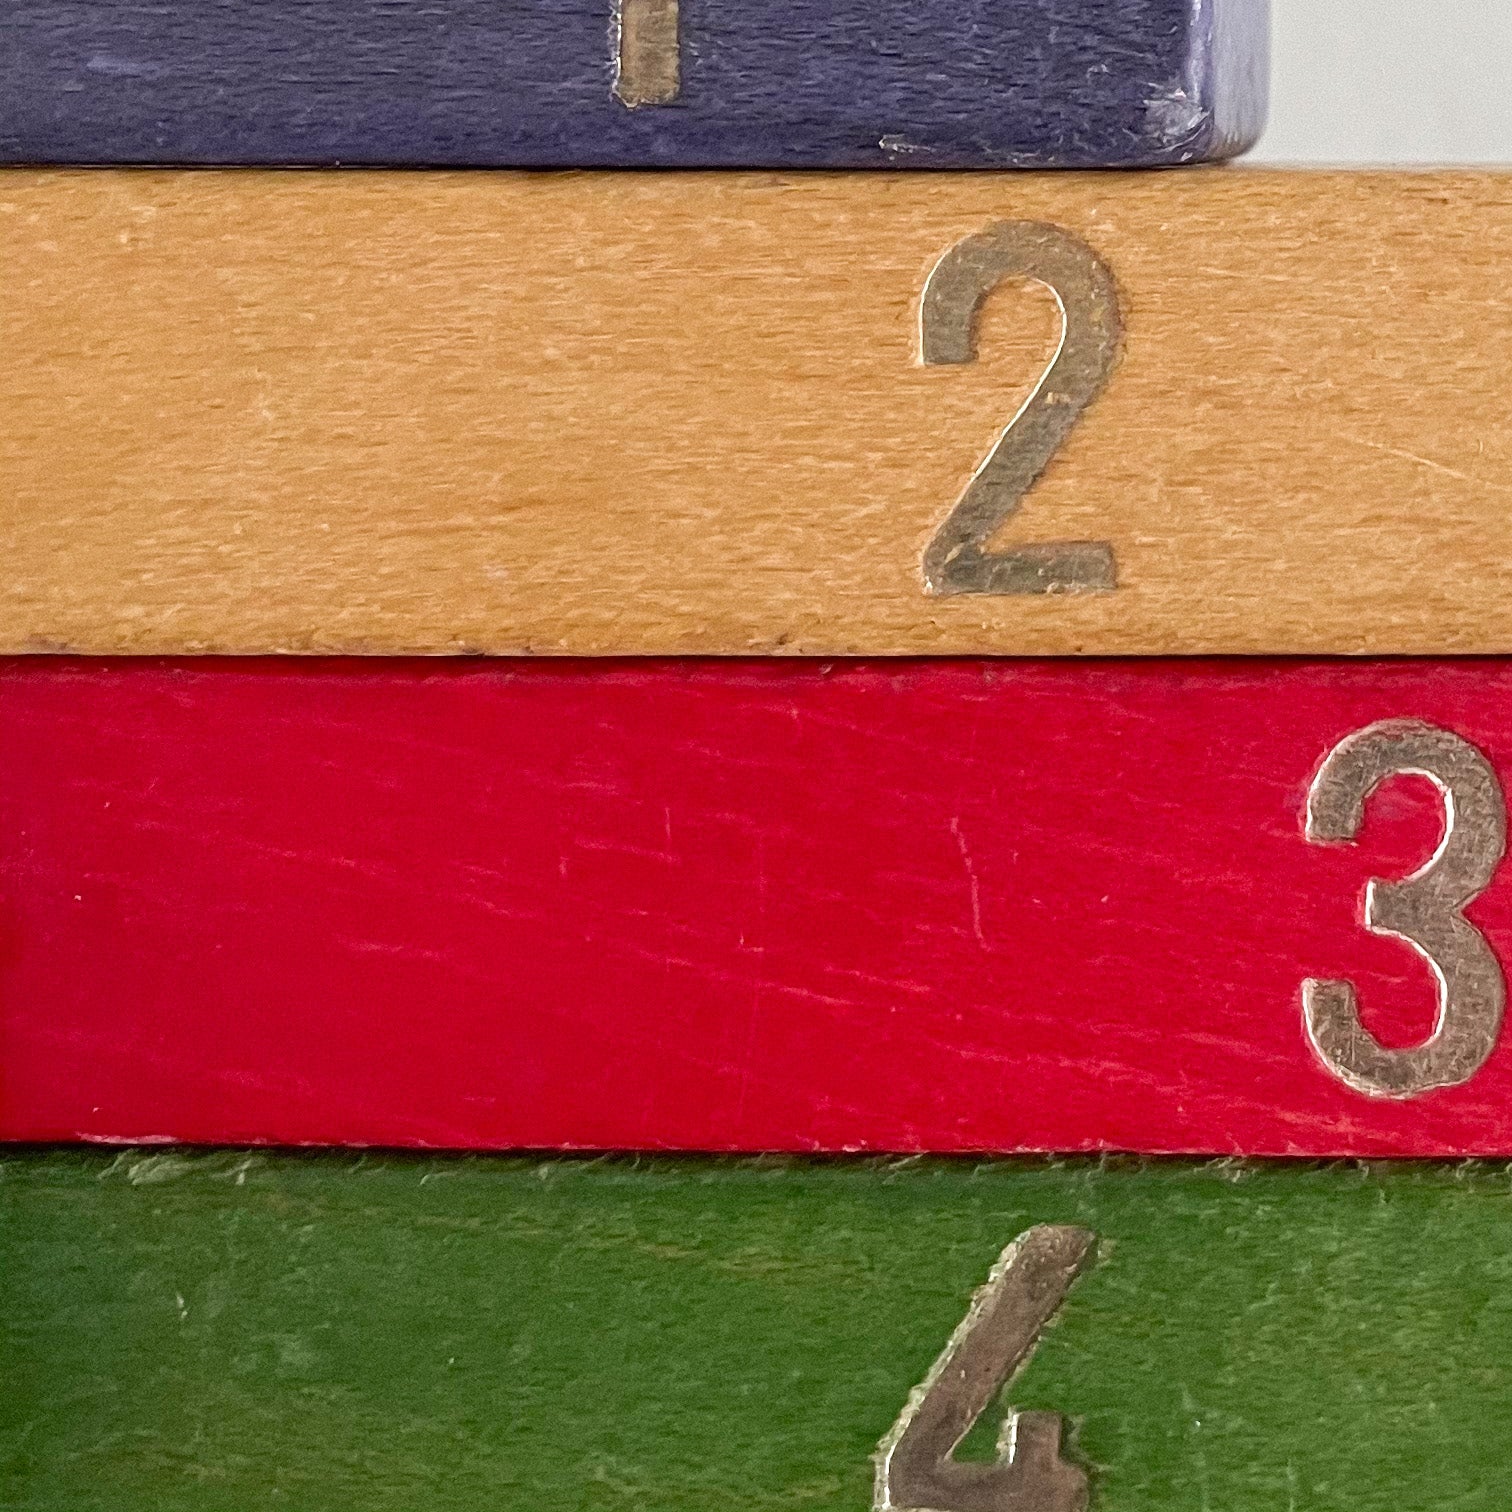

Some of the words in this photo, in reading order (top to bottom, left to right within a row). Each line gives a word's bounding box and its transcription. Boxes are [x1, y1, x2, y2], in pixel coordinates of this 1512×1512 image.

[914, 221, 1120, 596] 2
[1302, 719, 1507, 1101] 3
[876, 1224, 1092, 1512] 4
